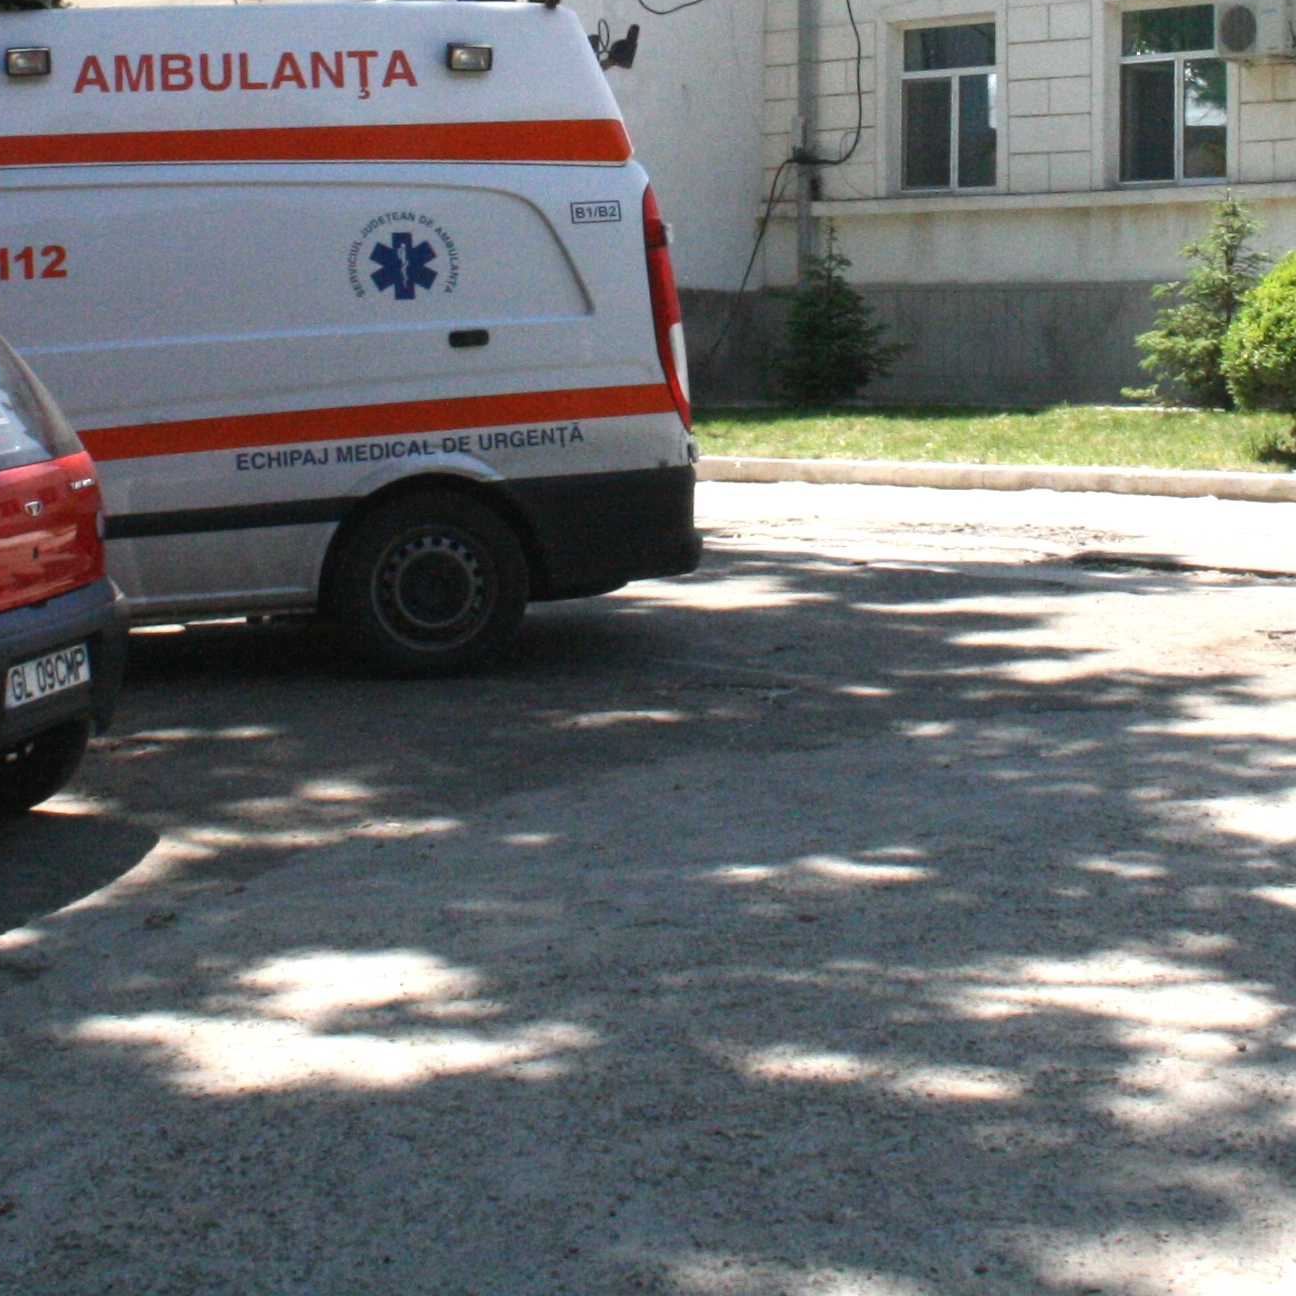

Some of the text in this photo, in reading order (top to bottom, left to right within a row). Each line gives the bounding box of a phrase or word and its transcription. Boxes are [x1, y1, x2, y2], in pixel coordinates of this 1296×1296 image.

[419, 215, 434, 228] DE
[575, 206, 617, 219] B1/B2
[236, 448, 329, 471] ECHIPAJ
[336, 439, 435, 463] MEDICAL
[442, 436, 472, 454] DE
[12, 647, 84, 701] GL 09CMP
